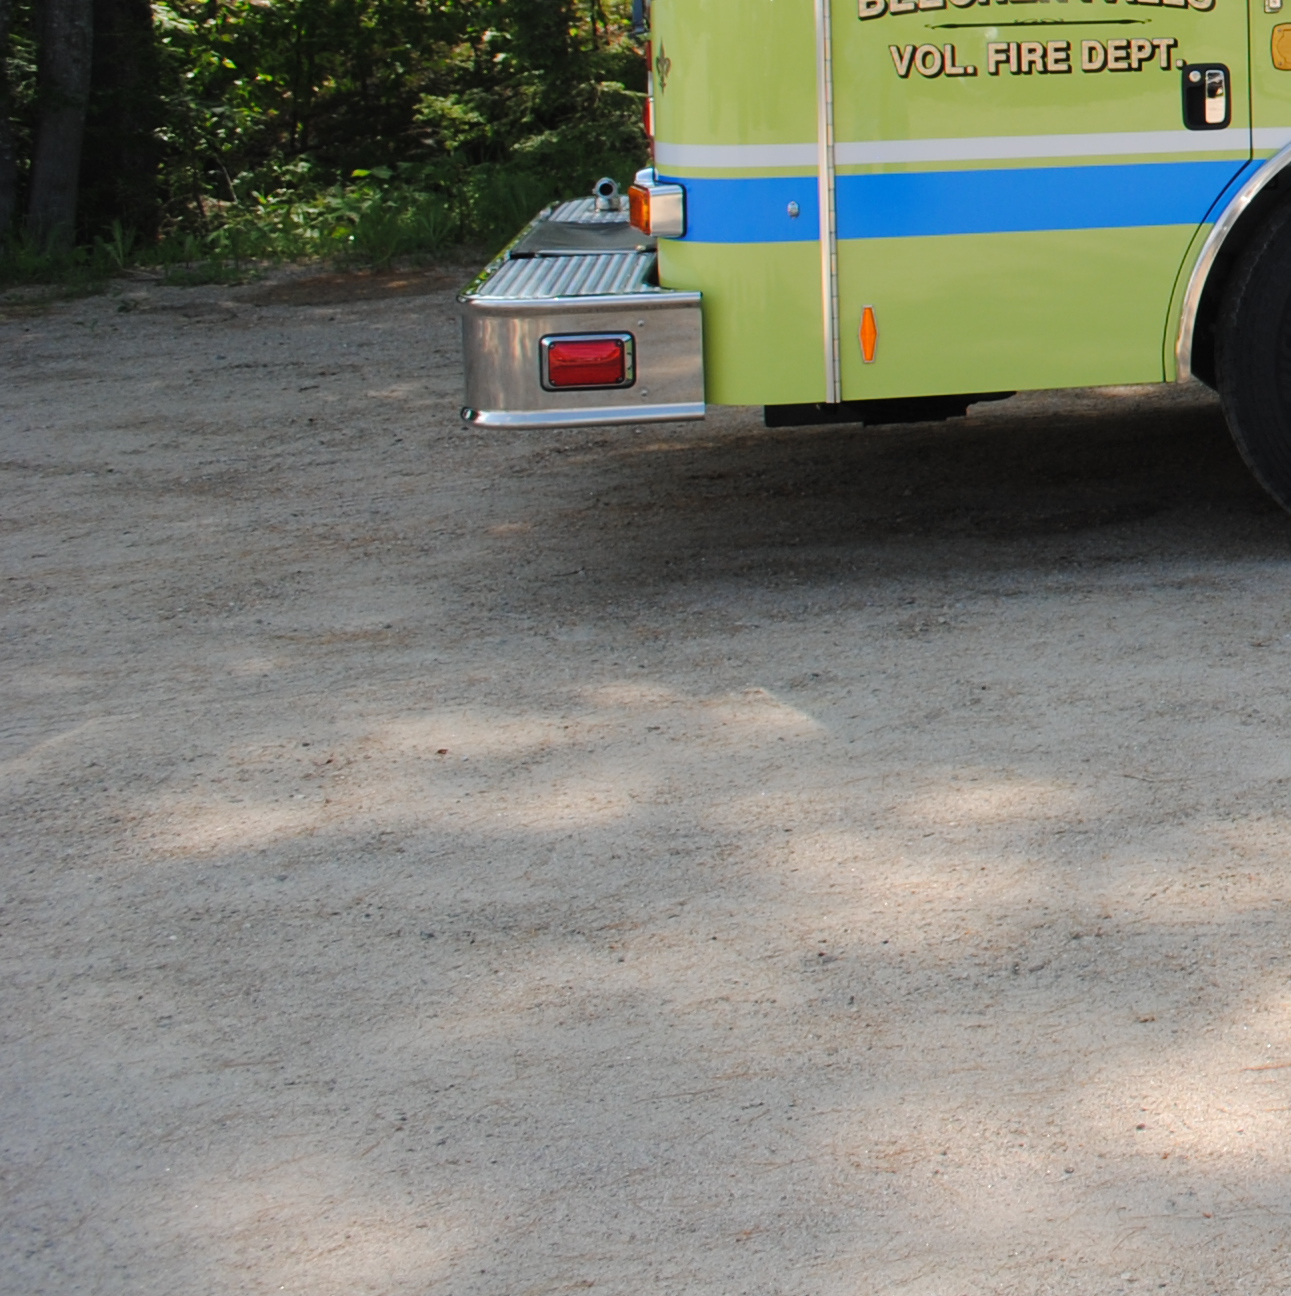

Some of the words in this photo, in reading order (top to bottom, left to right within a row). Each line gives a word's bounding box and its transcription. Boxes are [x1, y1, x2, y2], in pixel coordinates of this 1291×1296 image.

[889, 43, 978, 78] VOL.
[987, 40, 1072, 75] FIRE
[1081, 37, 1187, 73] DEPT.
